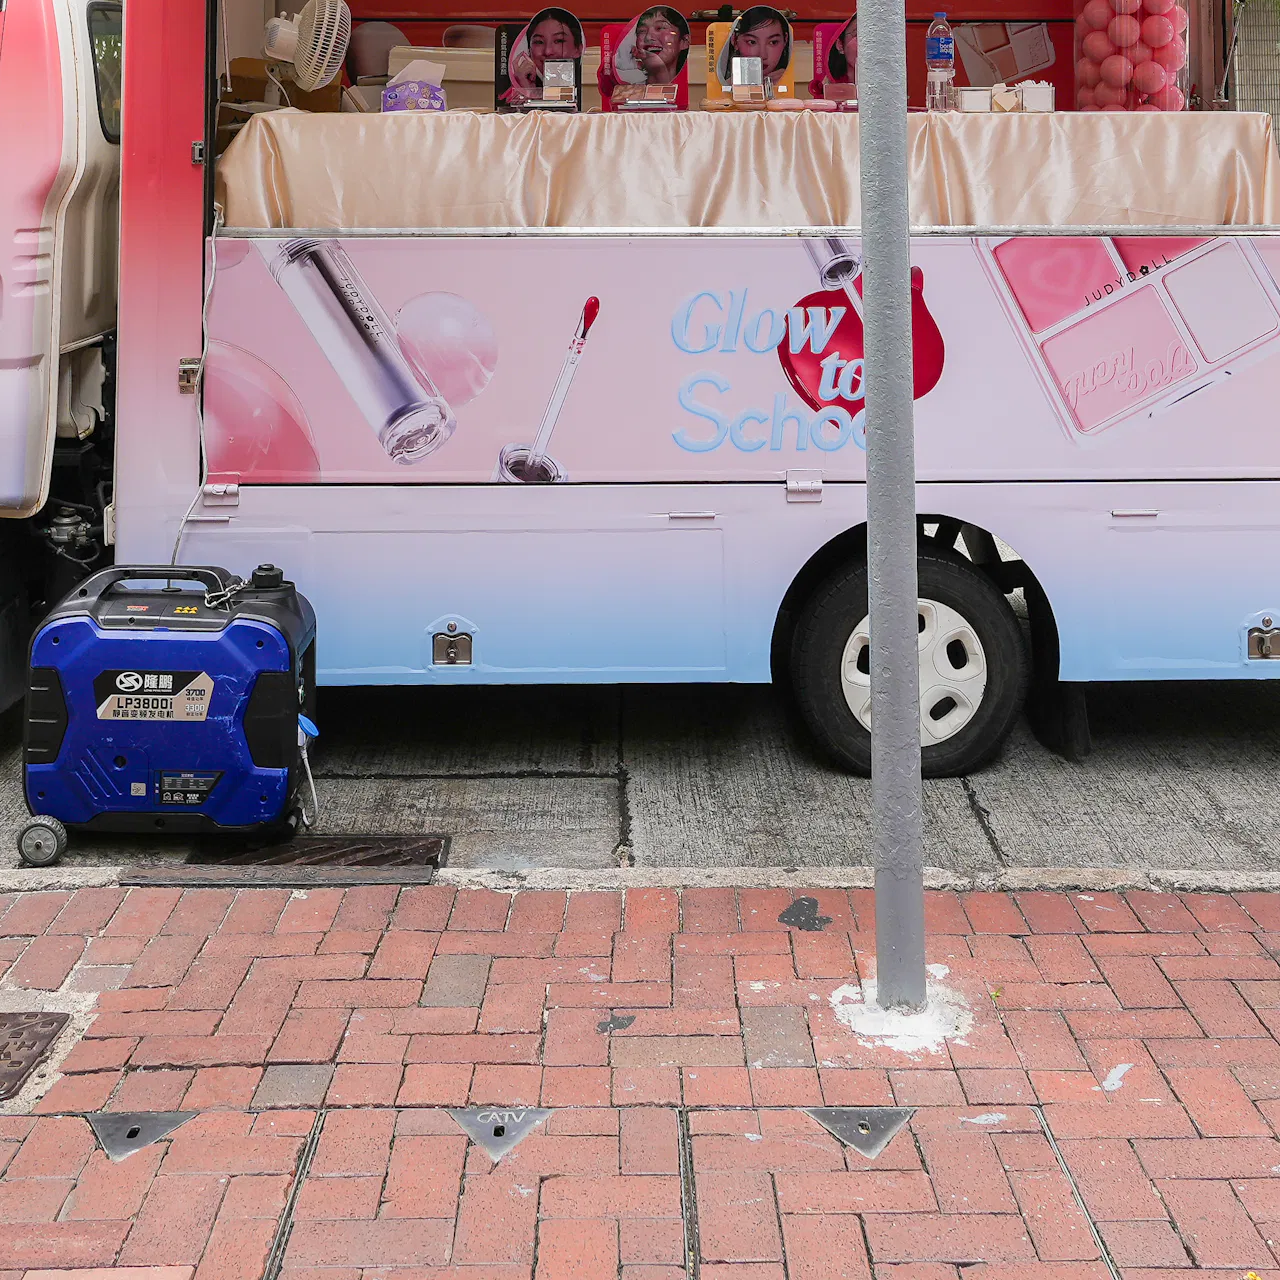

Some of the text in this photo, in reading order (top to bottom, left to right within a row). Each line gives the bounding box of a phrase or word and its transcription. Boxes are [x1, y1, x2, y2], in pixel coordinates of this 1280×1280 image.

[671, 287, 847, 354] Glow
[818, 351, 866, 402] to
[671, 370, 867, 453] Scho
[144, 674, 173, 689] 隆鹏
[117, 697, 173, 710] LP3800i
[185, 704, 205, 712] 3300
[112, 709, 174, 719] 静音变频发电机
